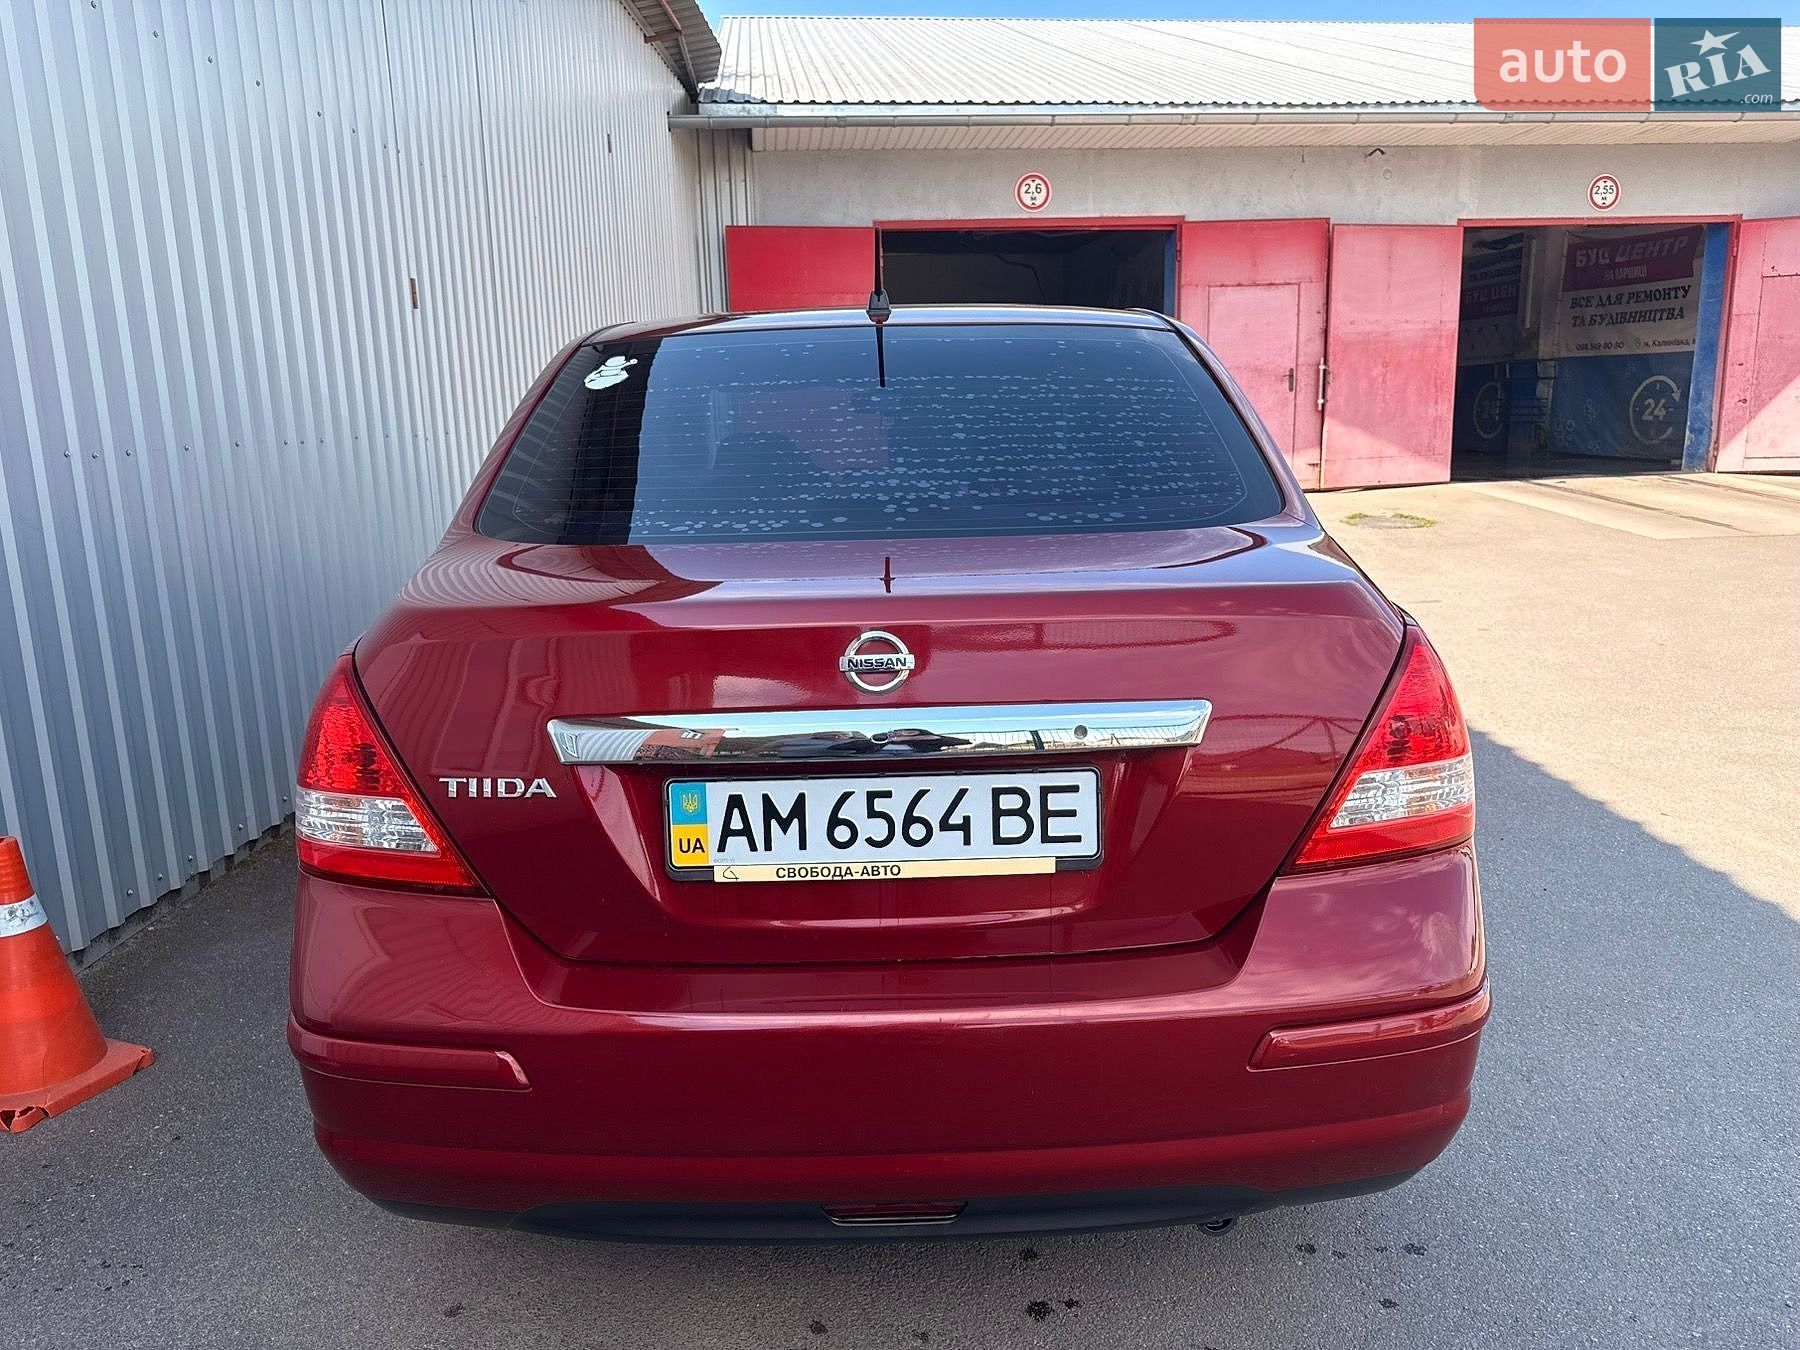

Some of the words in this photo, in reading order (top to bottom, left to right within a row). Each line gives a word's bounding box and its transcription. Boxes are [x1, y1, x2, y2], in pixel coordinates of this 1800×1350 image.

[1024, 183, 1042, 194] 2,6
[1594, 185, 1614, 195] 2,55
[1615, 235, 1689, 262] ЦЕНТР
[1569, 295, 1594, 309] ВСЕ
[1596, 292, 1625, 307] ДЛЯ
[1626, 284, 1692, 304] РЕМОНТУ
[1572, 315, 1586, 327] ТА
[1588, 306, 1685, 327] БУДІВНИЦТВА
[1641, 398, 1667, 421] 24
[846, 656, 908, 670] NISSAN
[439, 777, 557, 799] TIIDA
[716, 791, 808, 853] AM
[825, 787, 973, 850] 6564
[991, 784, 1083, 846] BE
[678, 838, 706, 855] UA
[775, 864, 902, 881] СВОБОДА-АВТО
